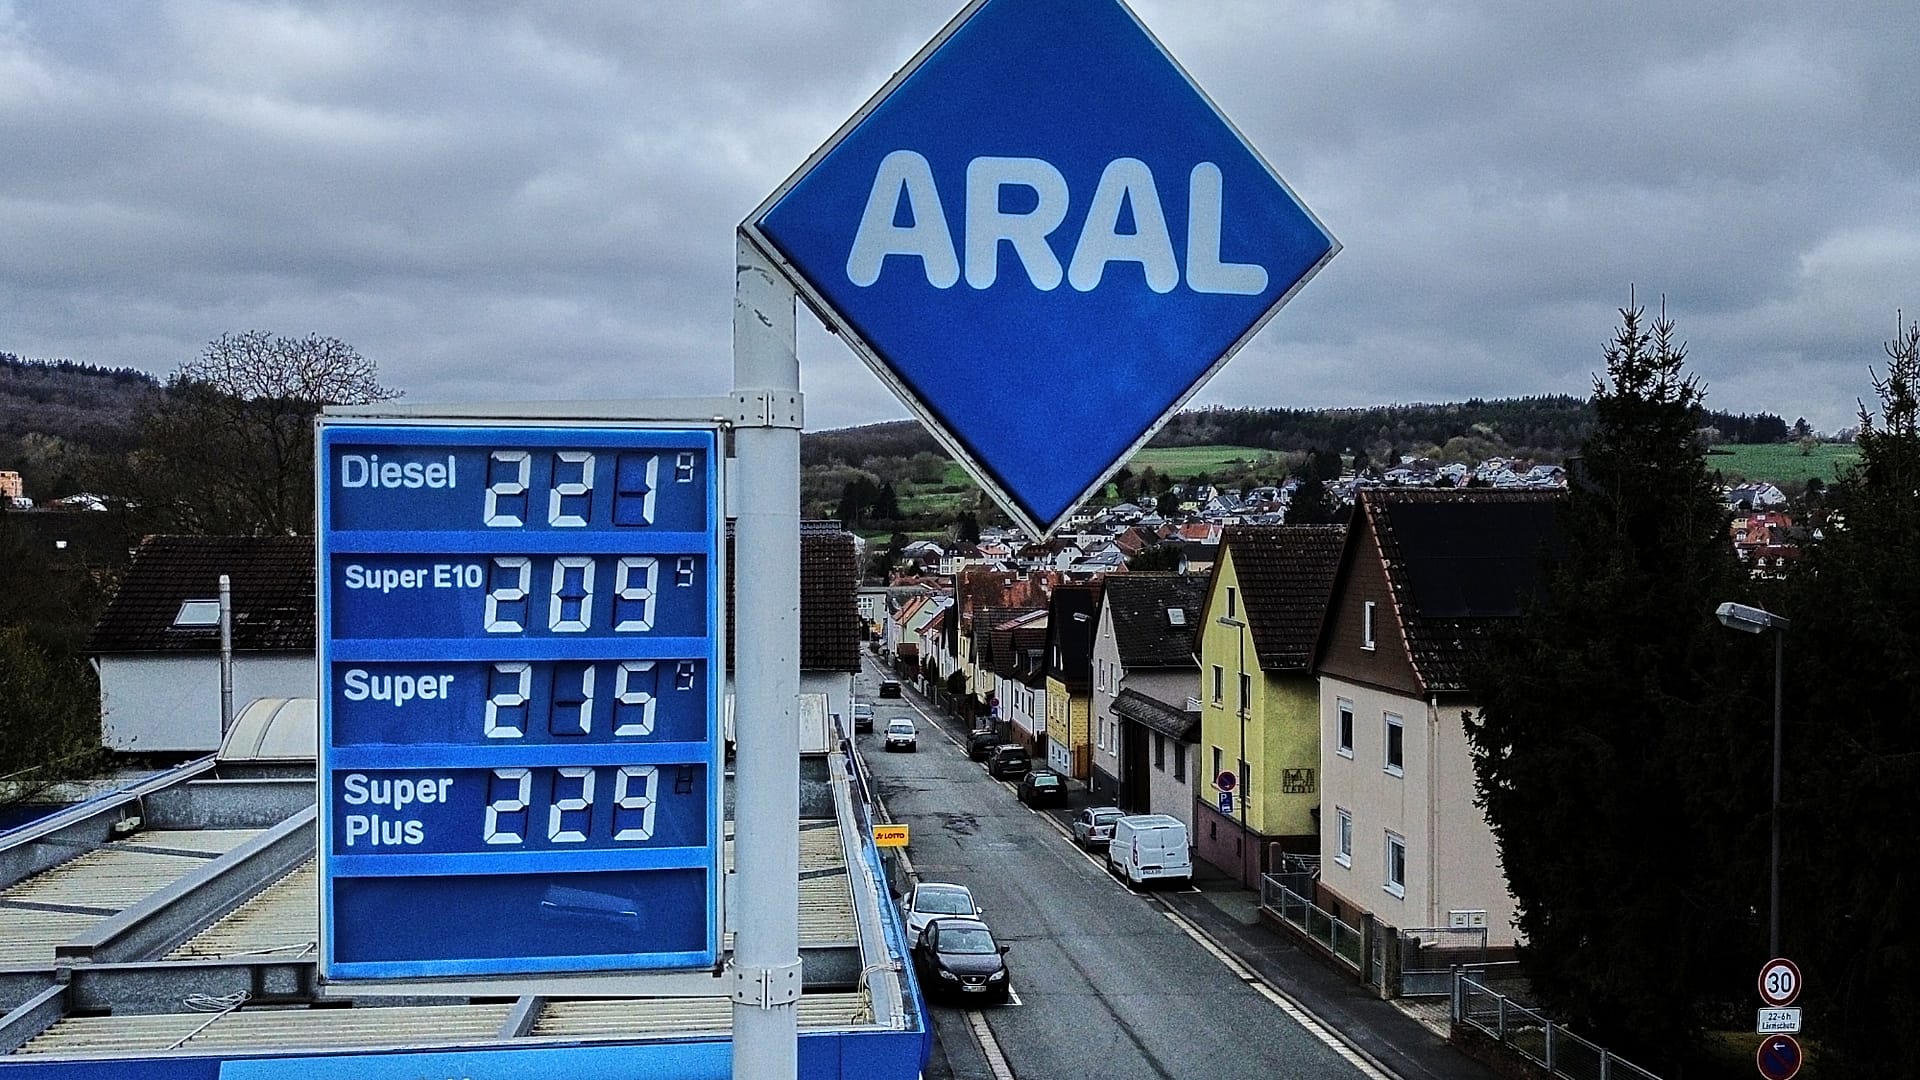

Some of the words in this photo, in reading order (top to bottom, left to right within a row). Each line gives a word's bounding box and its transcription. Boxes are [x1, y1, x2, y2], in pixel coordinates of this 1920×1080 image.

[846, 149, 1269, 296] ARAL
[341, 454, 456, 489] Diesel
[345, 565, 428, 593] Super
[434, 564, 483, 588] E10
[344, 669, 454, 706] Super
[344, 774, 453, 809] Super
[484, 767, 659, 844] 229
[346, 815, 424, 845] Plus
[1768, 972, 1792, 993] 30
